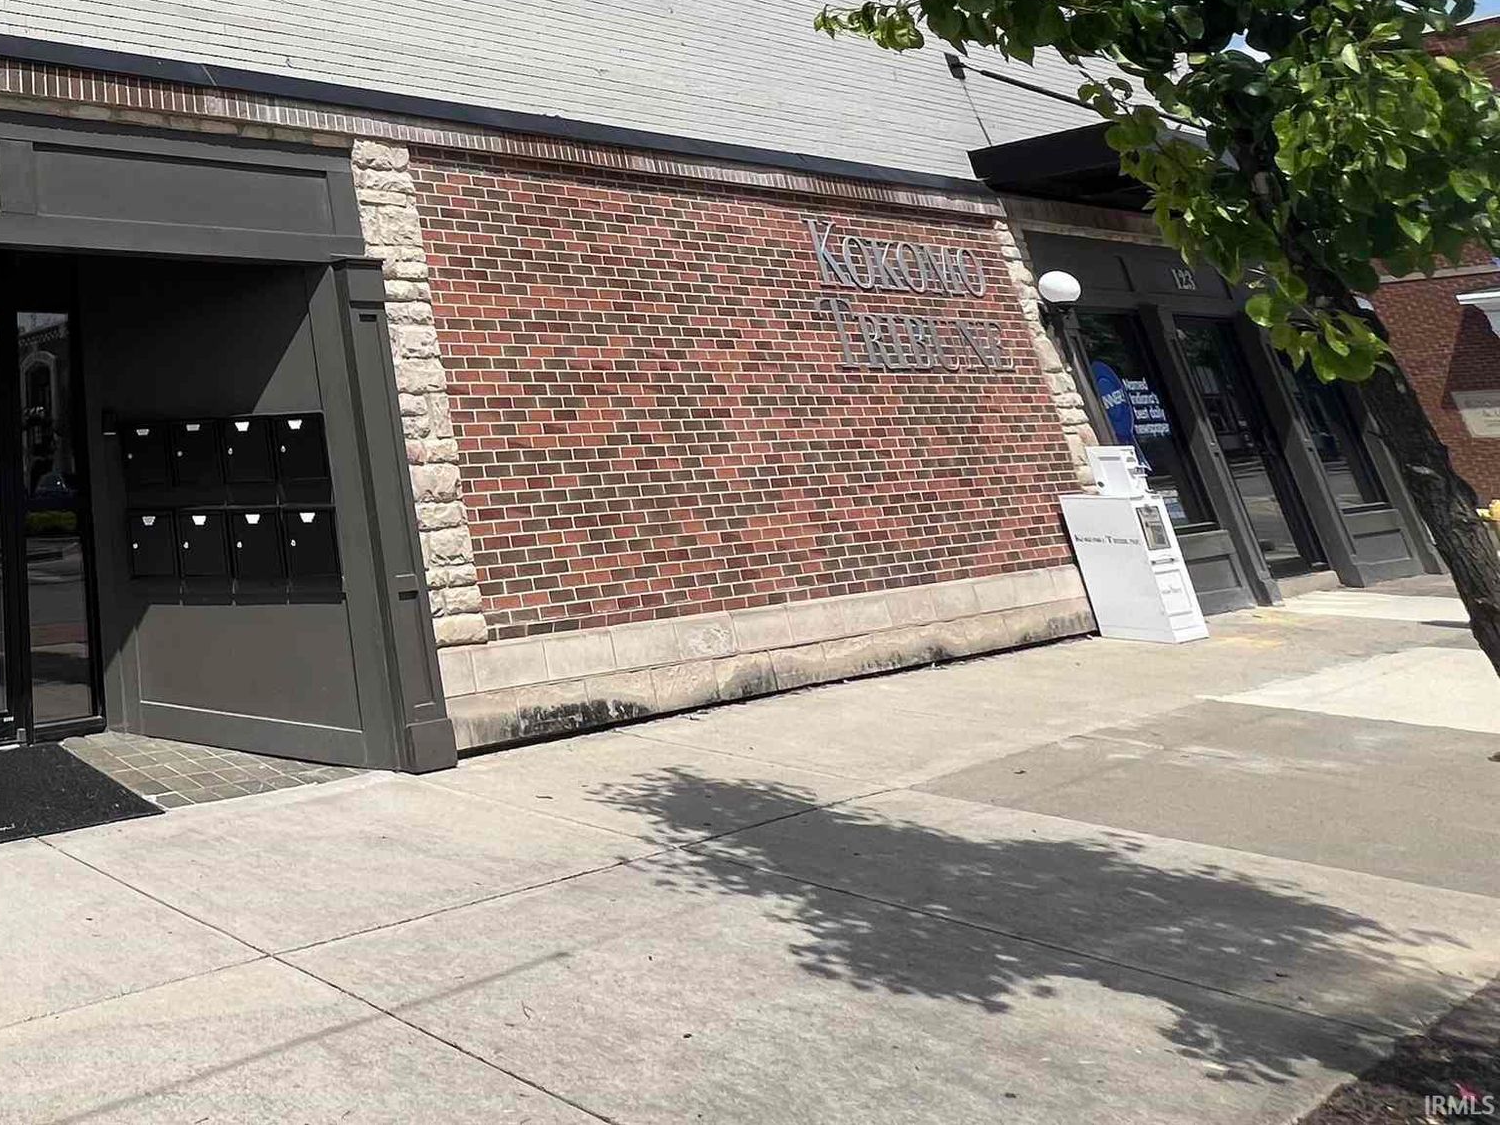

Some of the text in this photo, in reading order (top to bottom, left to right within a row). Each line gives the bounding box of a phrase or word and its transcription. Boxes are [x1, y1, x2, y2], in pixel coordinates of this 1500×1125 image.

[802, 218, 987, 297] KOKOMO
[1171, 268, 1196, 290] 123
[813, 297, 1017, 374] TRIBUNE
[1122, 376, 1149, 390] Named
[1129, 391, 1160, 405] Indiana's
[1133, 405, 1167, 421] best daily
